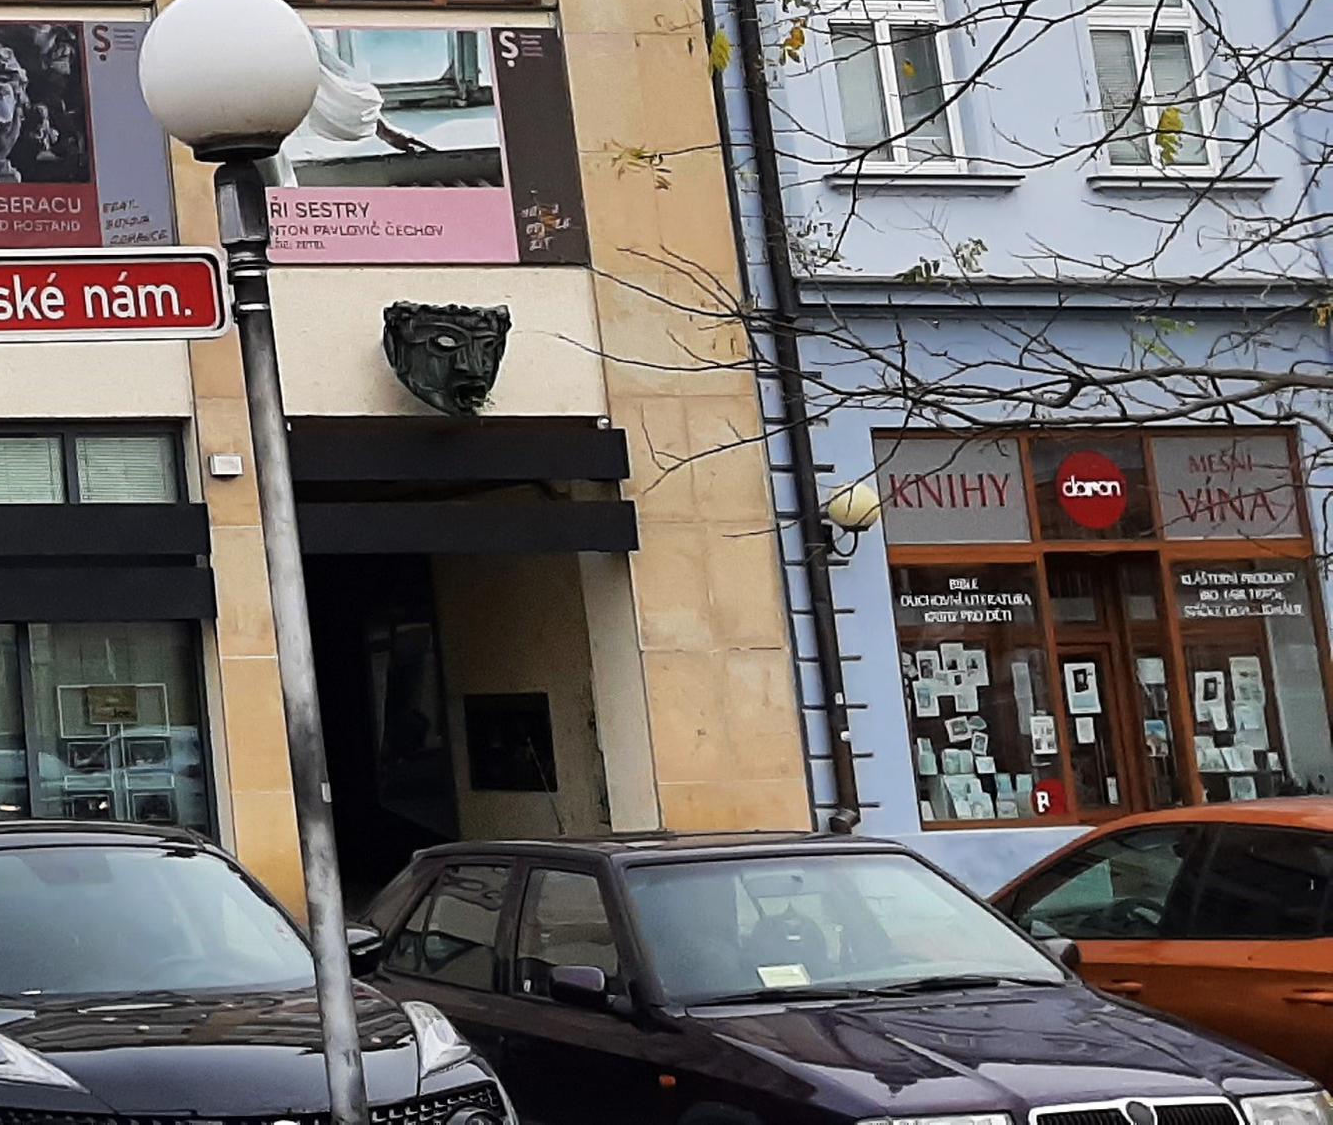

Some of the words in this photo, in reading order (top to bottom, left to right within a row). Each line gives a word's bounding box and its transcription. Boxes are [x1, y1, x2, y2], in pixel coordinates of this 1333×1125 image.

[295, 201, 370, 219] SESTRY
[13, 219, 81, 233] ROSTAND
[313, 220, 380, 237] PAVLOVIČ
[385, 221, 444, 237] ČECHOV
[83, 271, 193, 318] nám.
[889, 473, 1012, 509] KNIHY
[1177, 476, 1277, 522] VÍNA
